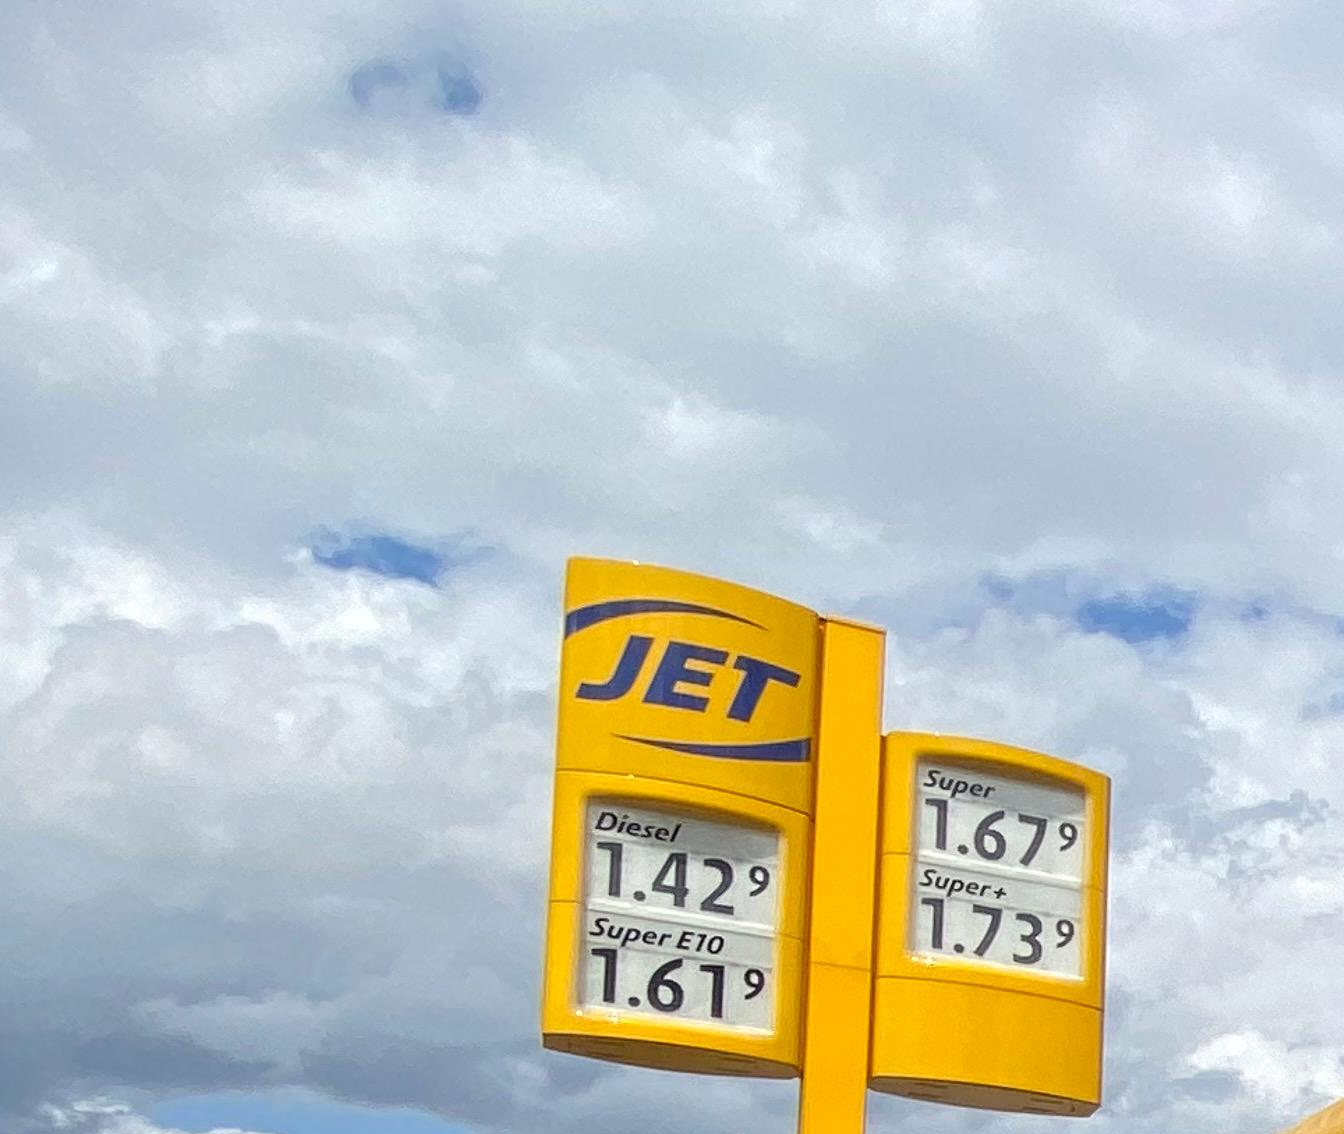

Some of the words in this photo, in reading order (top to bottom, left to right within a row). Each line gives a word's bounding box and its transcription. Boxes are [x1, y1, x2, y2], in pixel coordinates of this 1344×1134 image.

[576, 635, 800, 723] JET
[924, 769, 996, 799] Super
[595, 811, 682, 843] Diesel
[919, 869, 1008, 898] Super+
[589, 917, 673, 947] Super
[676, 931, 725, 955] E10
